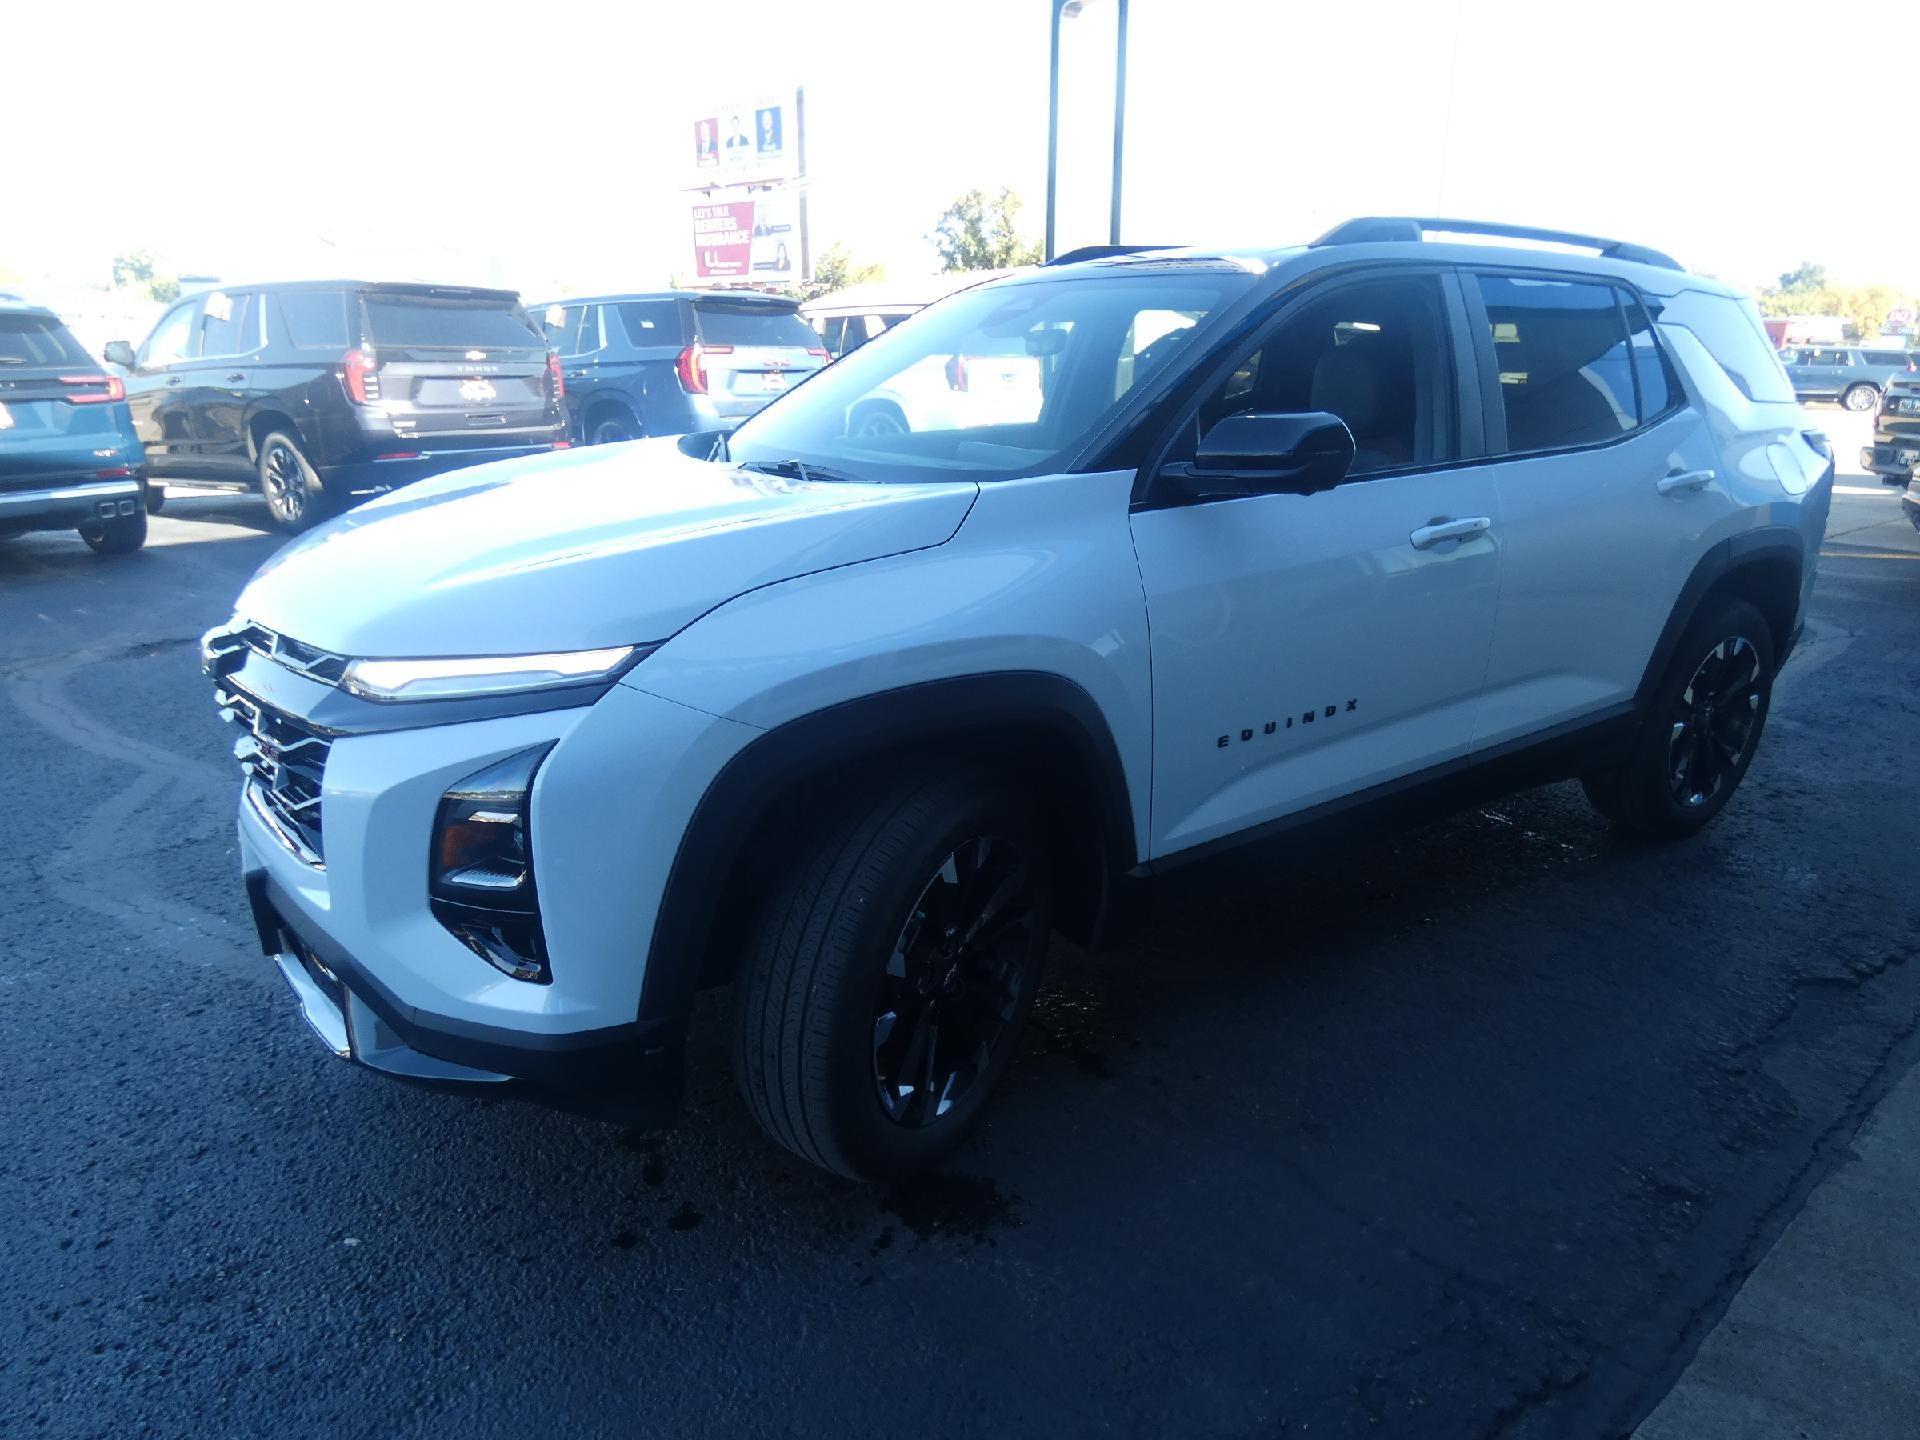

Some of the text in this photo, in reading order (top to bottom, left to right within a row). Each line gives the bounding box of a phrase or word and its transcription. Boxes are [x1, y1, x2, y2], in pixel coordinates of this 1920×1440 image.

[712, 206, 729, 217] TALK
[696, 230, 750, 246] INSURANCE
[1217, 698, 1358, 748] EQUINOX
